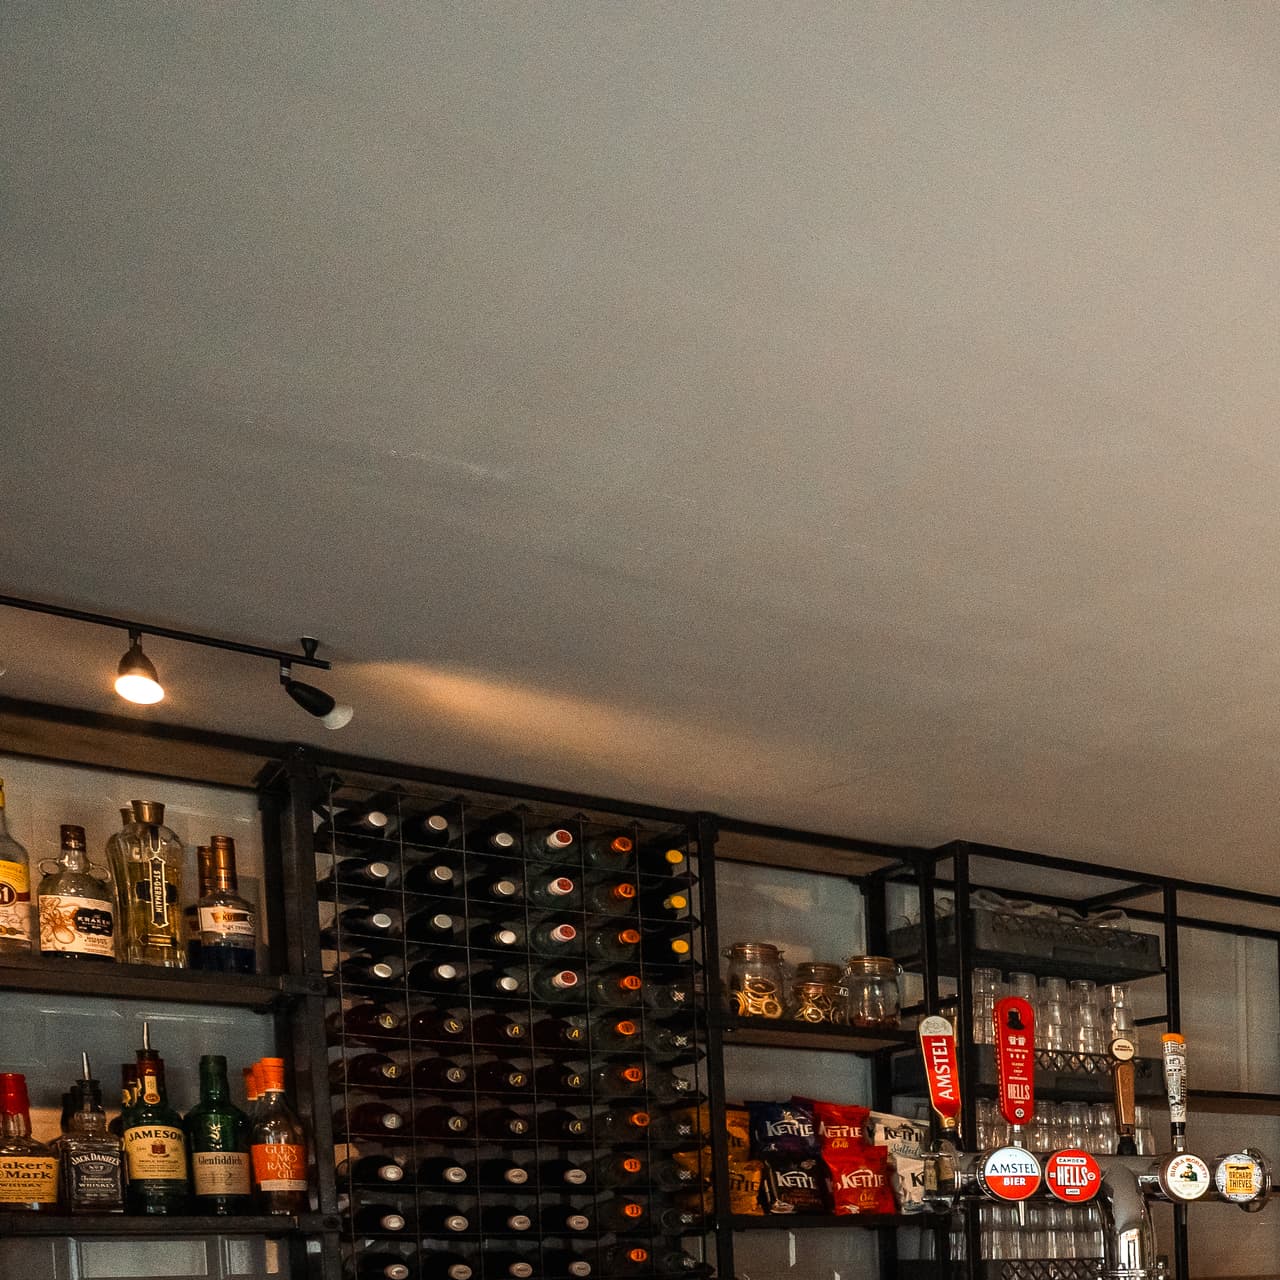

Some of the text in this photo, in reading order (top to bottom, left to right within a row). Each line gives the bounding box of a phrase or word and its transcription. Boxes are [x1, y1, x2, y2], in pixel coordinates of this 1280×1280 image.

[932, 1037, 953, 1101] AMSTEL
[1007, 1083, 1030, 1100] HELLS
[766, 1120, 815, 1137] KETTLE
[129, 1130, 184, 1143] JAMESON
[265, 1145, 297, 1154] GLEN
[71, 1154, 90, 1165] JACK
[198, 1154, 243, 1166] Glenfiddich
[0, 1161, 53, 1170] aker's
[989, 1163, 1036, 1174] AMSTEL
[5, 1170, 53, 1179] Mark
[1057, 1166, 1089, 1186] HELLS
[1003, 1177, 1026, 1186] BIER
[1229, 1179, 1252, 1188] THIEVES
